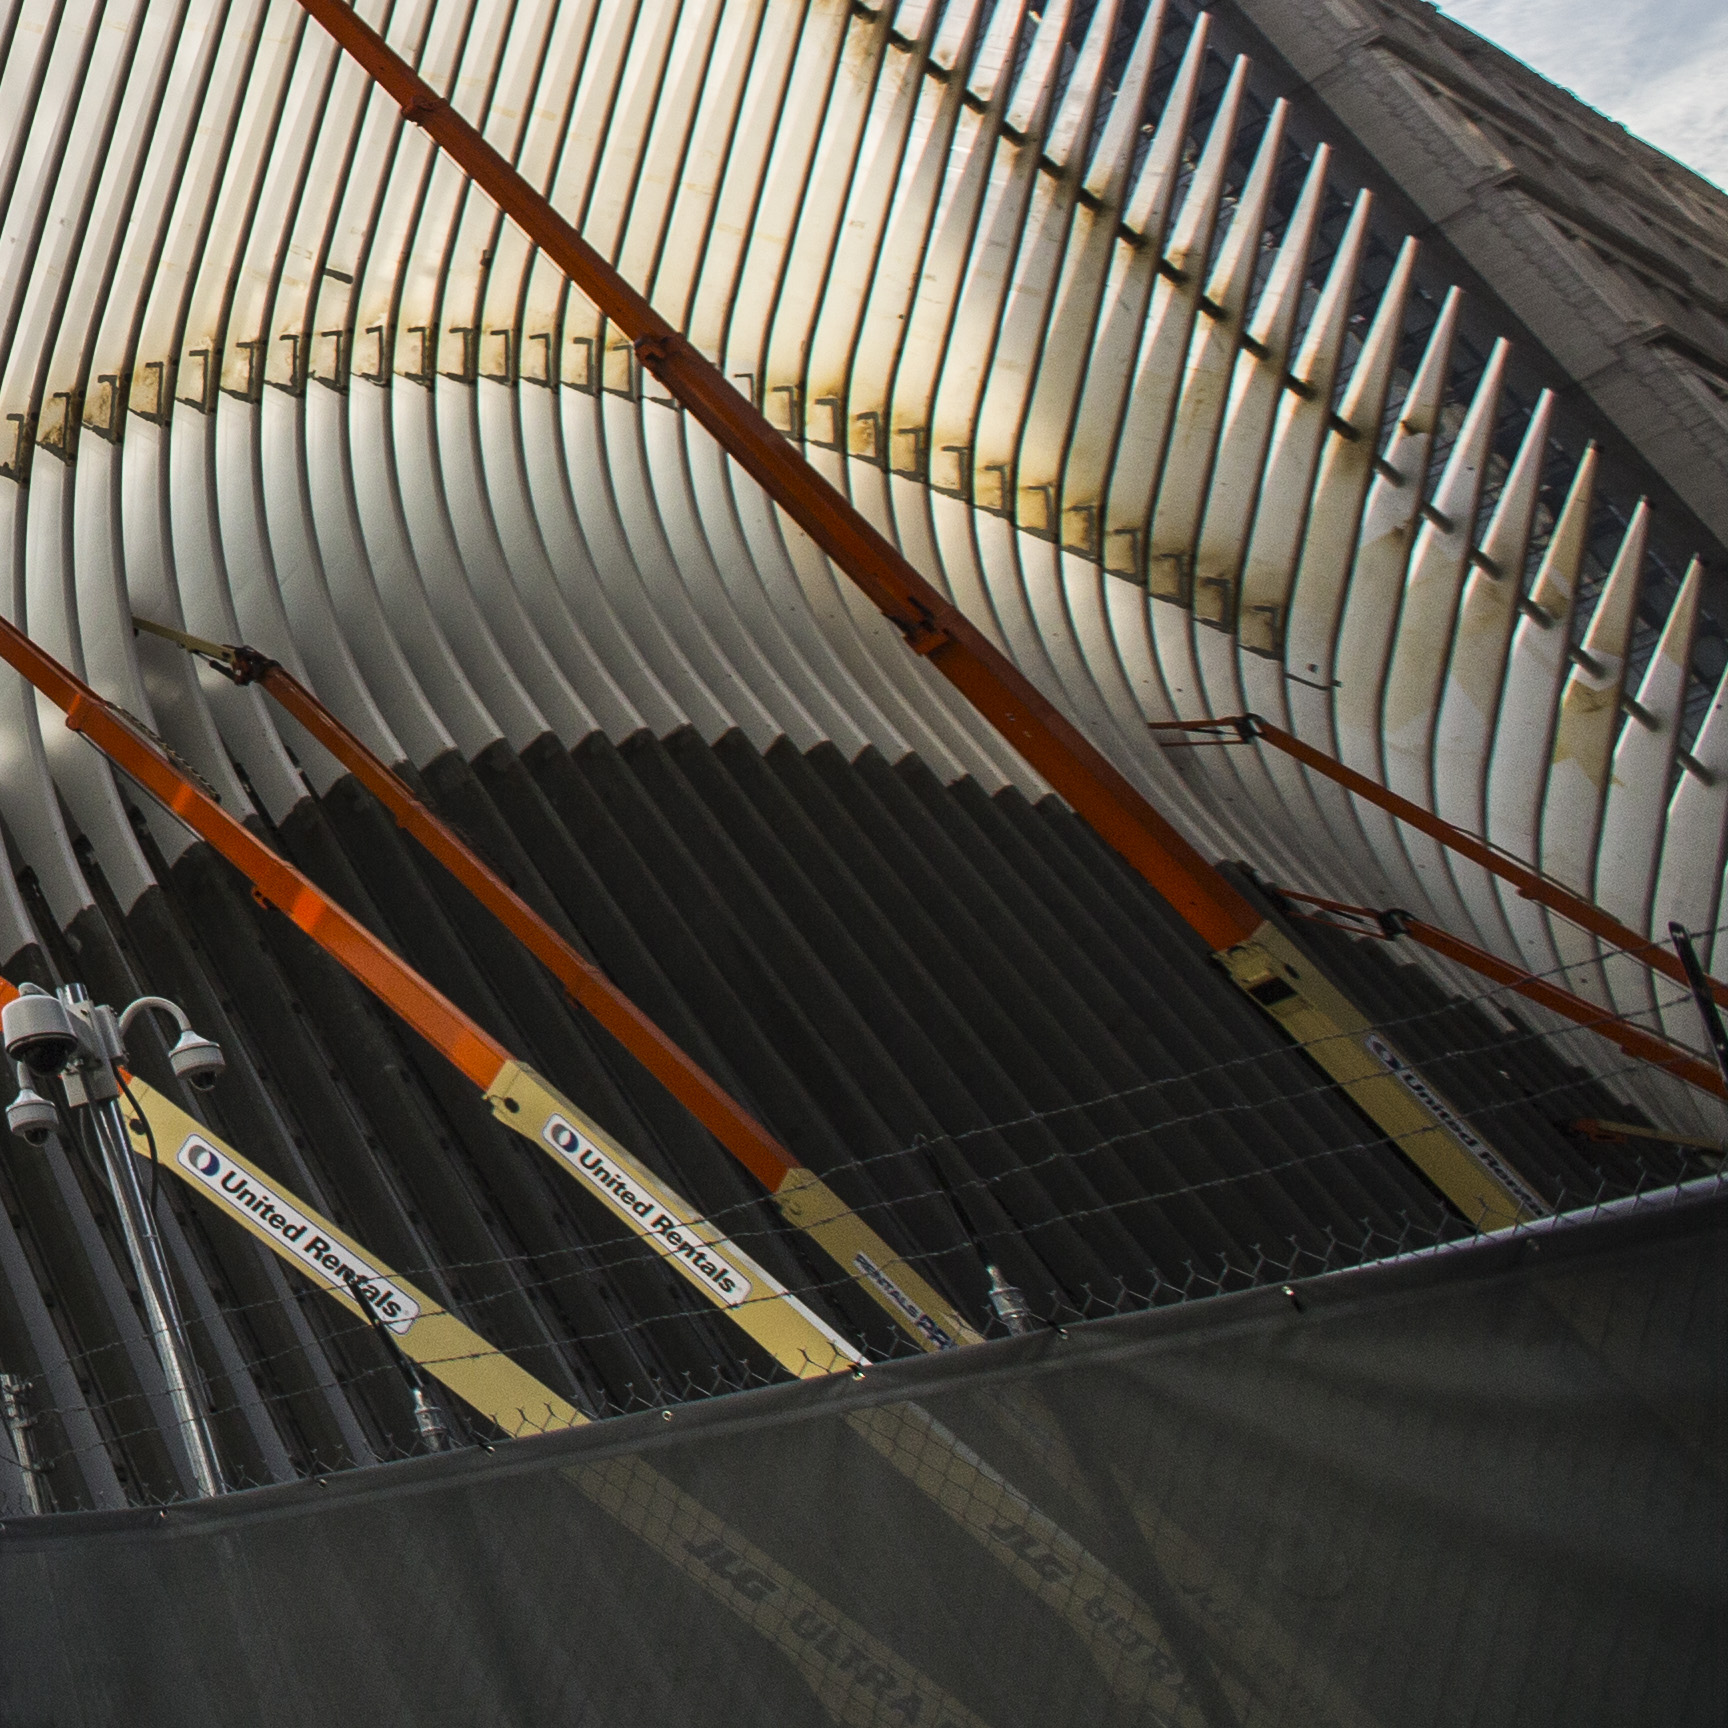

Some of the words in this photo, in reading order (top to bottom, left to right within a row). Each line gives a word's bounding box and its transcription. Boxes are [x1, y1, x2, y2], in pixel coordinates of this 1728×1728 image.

[221, 1170, 308, 1243] United
[579, 1149, 654, 1217] United
[650, 1214, 736, 1293] Rentals
